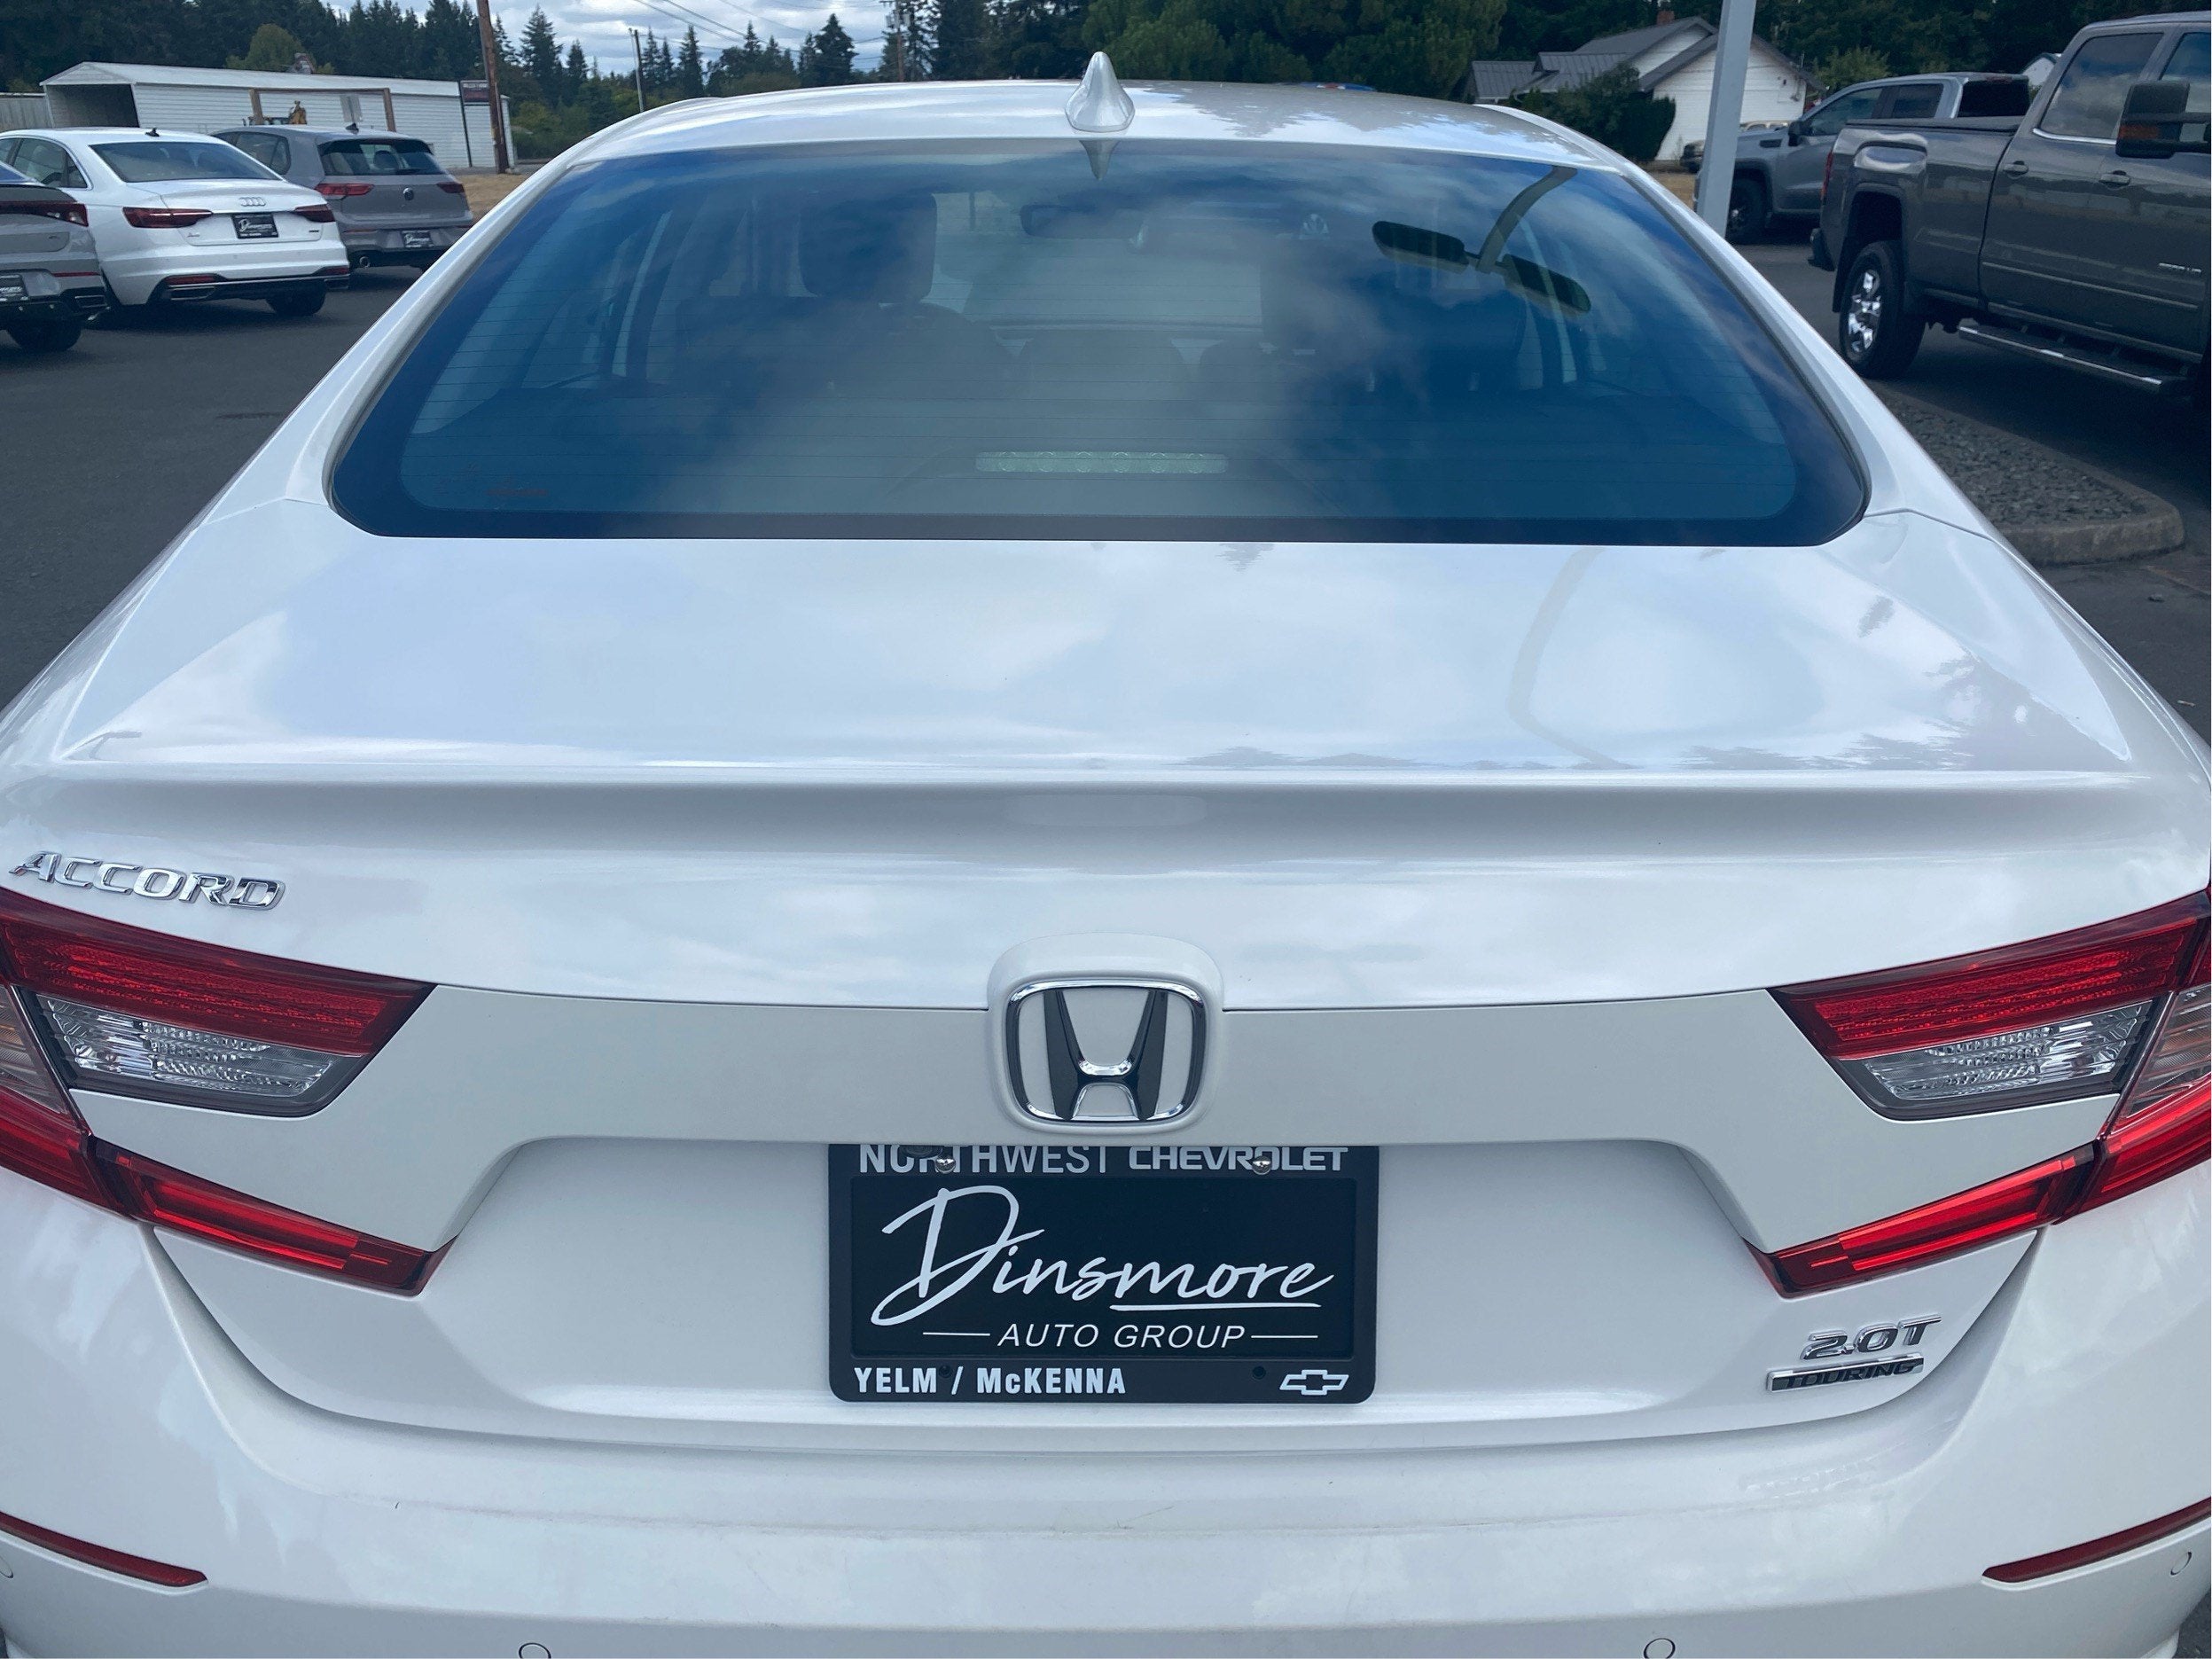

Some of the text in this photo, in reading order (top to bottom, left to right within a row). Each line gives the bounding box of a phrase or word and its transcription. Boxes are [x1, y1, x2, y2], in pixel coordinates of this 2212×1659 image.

[9, 850, 286, 911] ACCORD
[1129, 1146, 1348, 1171] CHEVROLET
[870, 1186, 1334, 1325] Dinsmore
[997, 1324, 1245, 1348] AUTO GROUP
[1800, 1314, 1942, 1359] 2.0T
[854, 1366, 1126, 1395] YELM / McKENNA
[1784, 1360, 1917, 1389] TOURING
